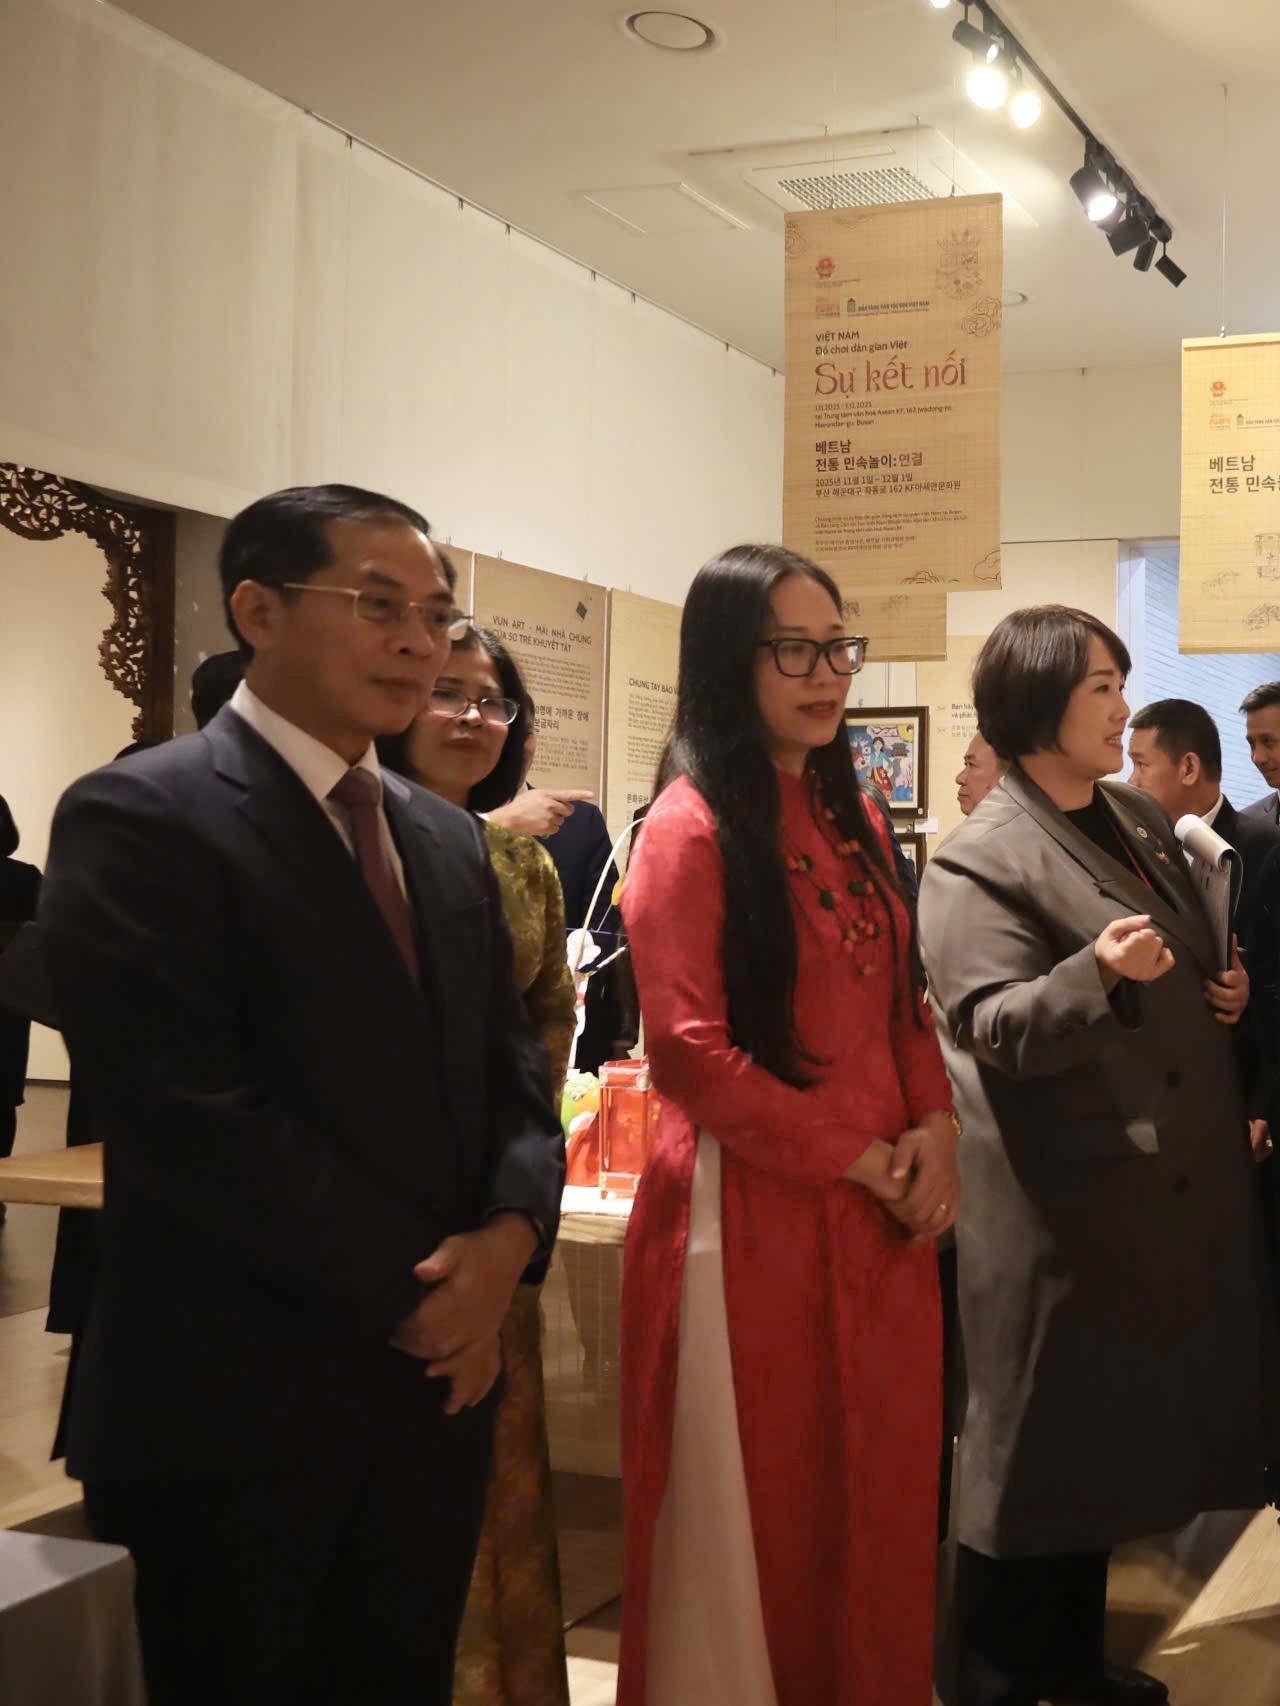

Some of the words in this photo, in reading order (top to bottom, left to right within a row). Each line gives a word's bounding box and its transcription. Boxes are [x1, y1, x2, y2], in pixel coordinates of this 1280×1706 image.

[815, 331, 835, 343] VIỆT
[838, 330, 860, 341] NAM
[815, 343, 829, 356] Đồ
[850, 341, 868, 353] dân
[869, 342, 888, 355] gian
[815, 361, 856, 399] Sự
[865, 354, 915, 391] kết
[924, 349, 968, 389] nối
[815, 439, 852, 454] 베트남
[815, 457, 841, 472] 전통
[843, 454, 897, 470] 민속놀이:
[899, 452, 923, 468] 연결
[1209, 455, 1256, 473] 베트남
[815, 477, 841, 487] 2025년
[843, 476, 860, 486] 11월
[862, 475, 874, 484] 1일
[882, 474, 898, 484] 12월
[1209, 476, 1240, 494] 전통
[815, 488, 830, 498] 부산
[832, 486, 862, 497] 해운대구
[889, 485, 902, 494] 162
[568, 632, 592, 646] CHUNG
[629, 678, 650, 690] CHUNG
[651, 682, 661, 692] TAY
[555, 707, 575, 719] 가까운
